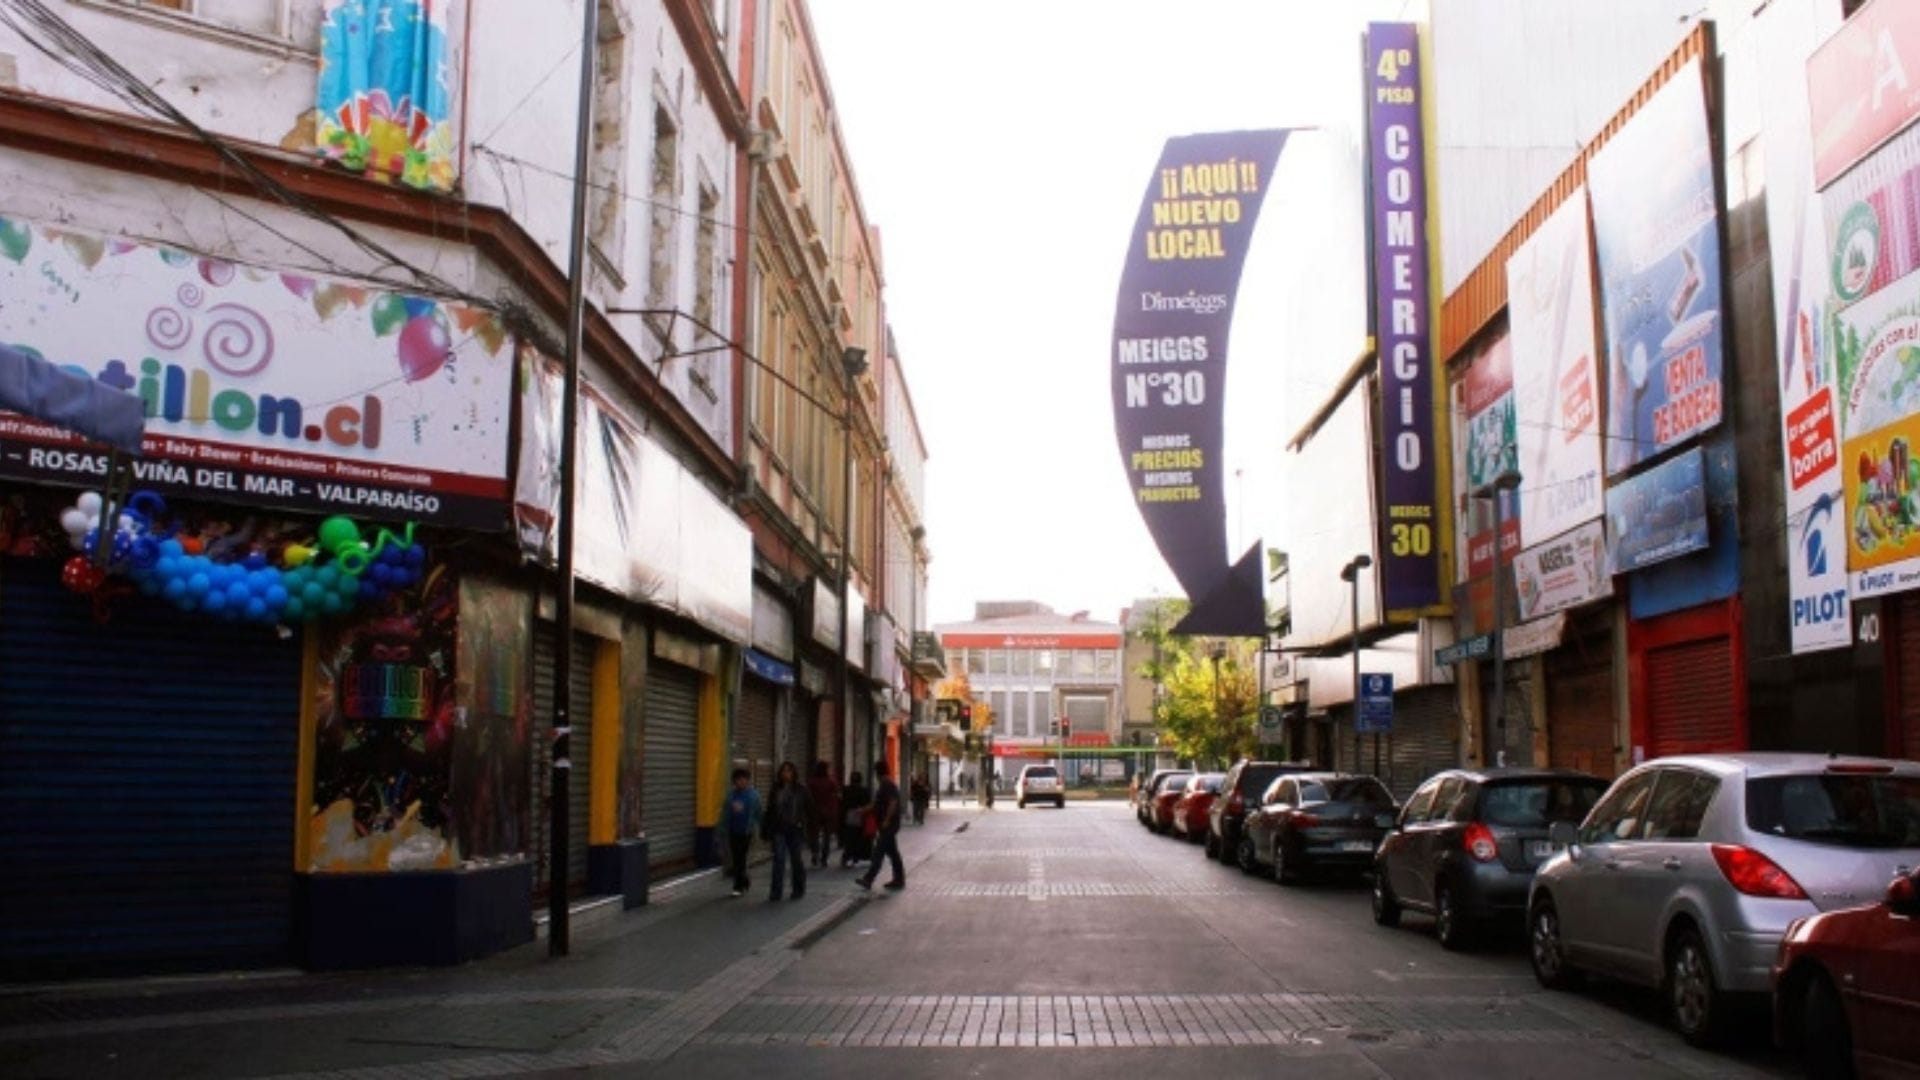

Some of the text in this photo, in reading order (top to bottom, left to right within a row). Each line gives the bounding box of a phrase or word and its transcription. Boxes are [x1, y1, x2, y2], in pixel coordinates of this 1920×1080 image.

[1377, 87, 1415, 105] PISO
[1153, 198, 1241, 226] NUEVO
[1147, 228, 1225, 260] LOCAL
[1141, 289, 1226, 313] Dimeiggs
[1384, 124, 1421, 471] COMERCIO
[1119, 336, 1208, 363] MEIGGS
[29, 448, 110, 475] ROSAS
[132, 459, 189, 485] VIÑA
[195, 468, 238, 490] DEL
[244, 474, 294, 496] MAR
[1132, 448, 1203, 470] PRECIOS
[1793, 438, 1834, 479] borra
[1391, 523, 1431, 557] 30
[1794, 589, 1846, 627] PILOT
[1859, 613, 1880, 642] 40
